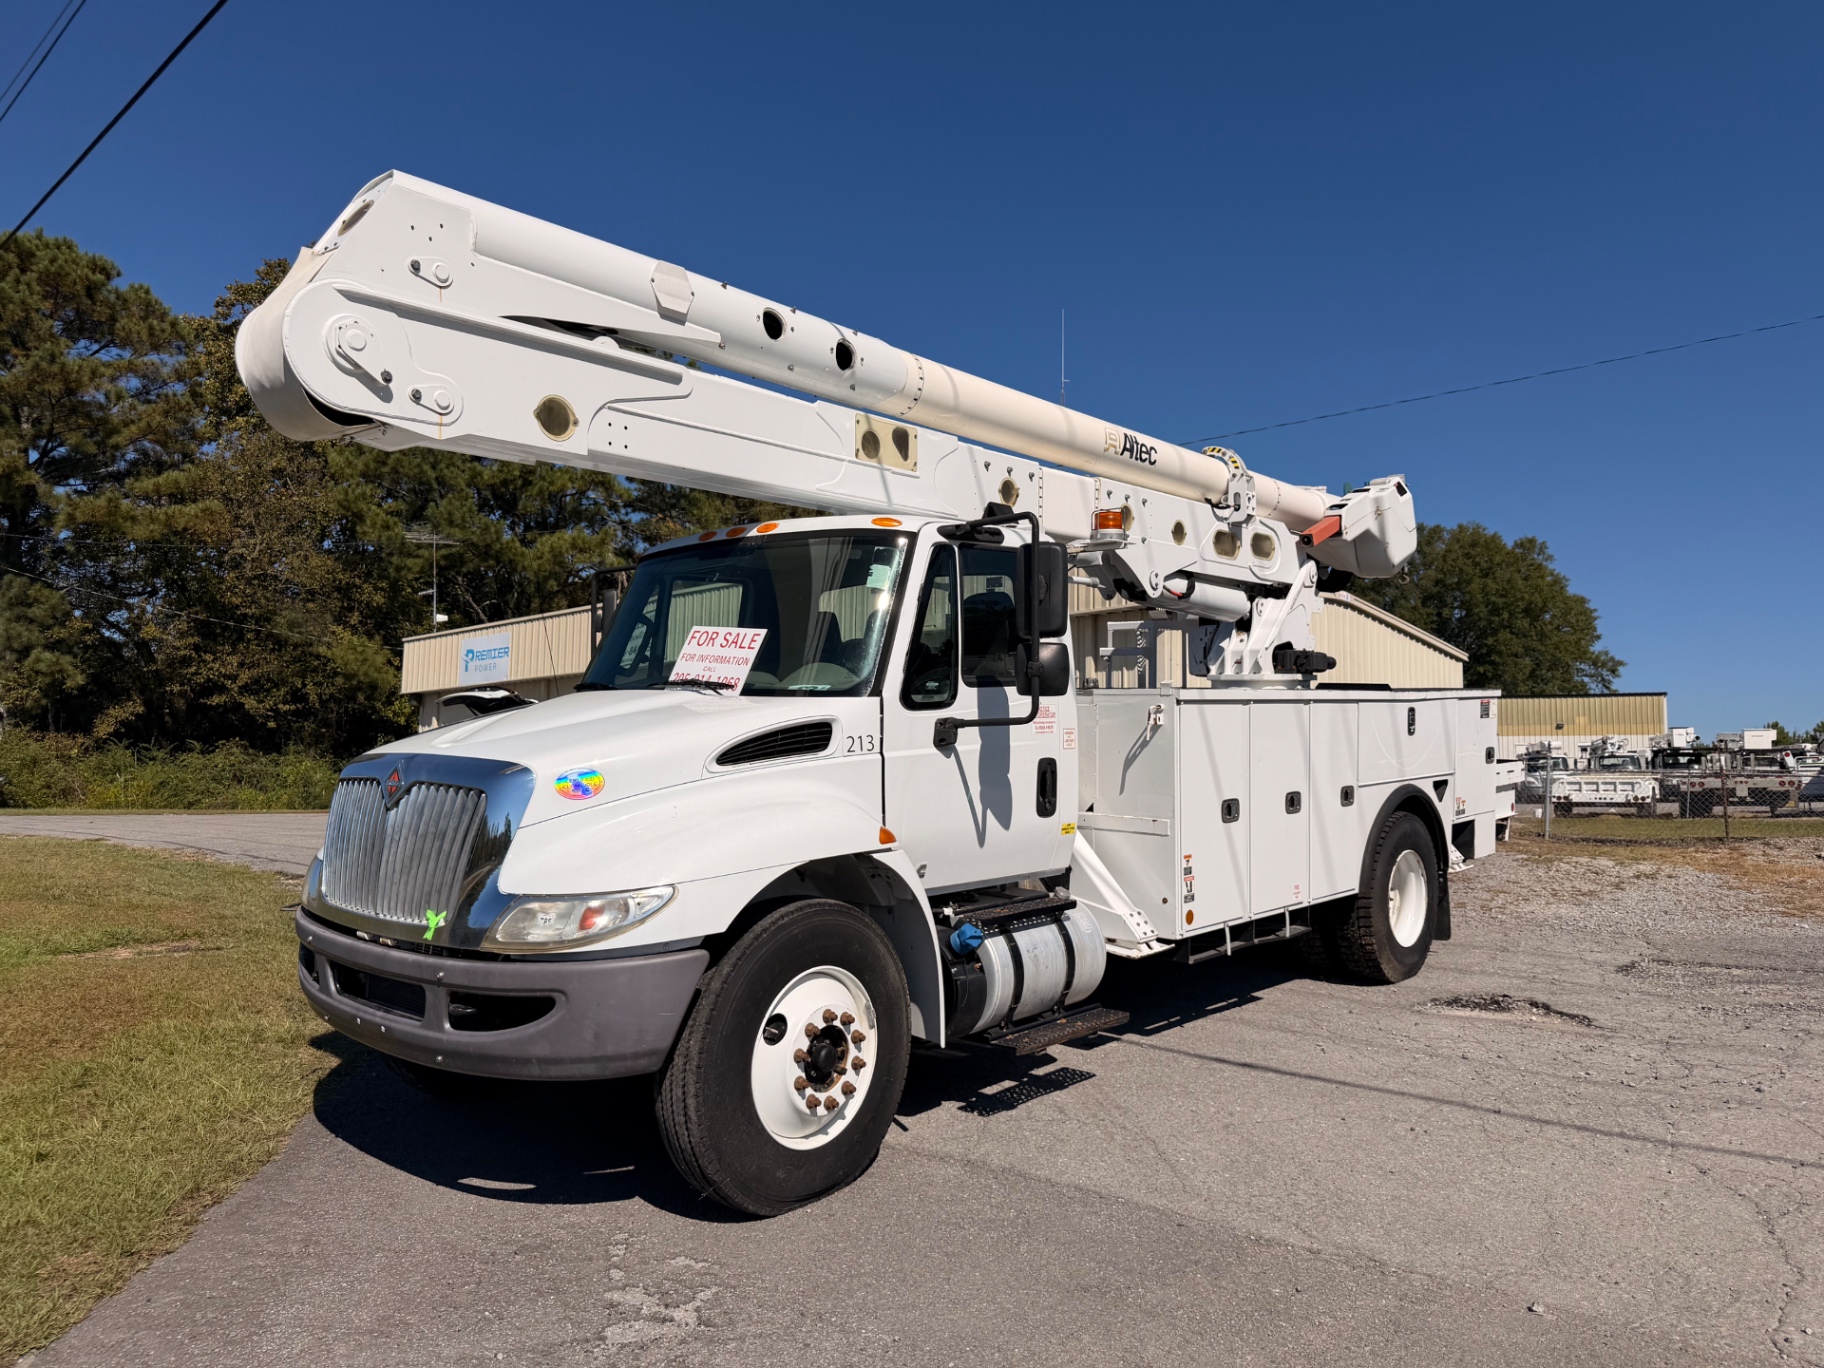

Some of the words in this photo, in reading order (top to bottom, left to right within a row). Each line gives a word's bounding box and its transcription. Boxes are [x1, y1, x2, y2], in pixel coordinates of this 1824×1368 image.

[1120, 432, 1158, 466] Altec
[688, 631, 720, 648] FOR
[720, 631, 761, 650] SALE
[462, 646, 510, 672] PREMIER
[475, 662, 497, 673] POWER
[680, 653, 696, 662] FOR
[696, 653, 750, 666] INFORMATION
[846, 734, 875, 752] 213
